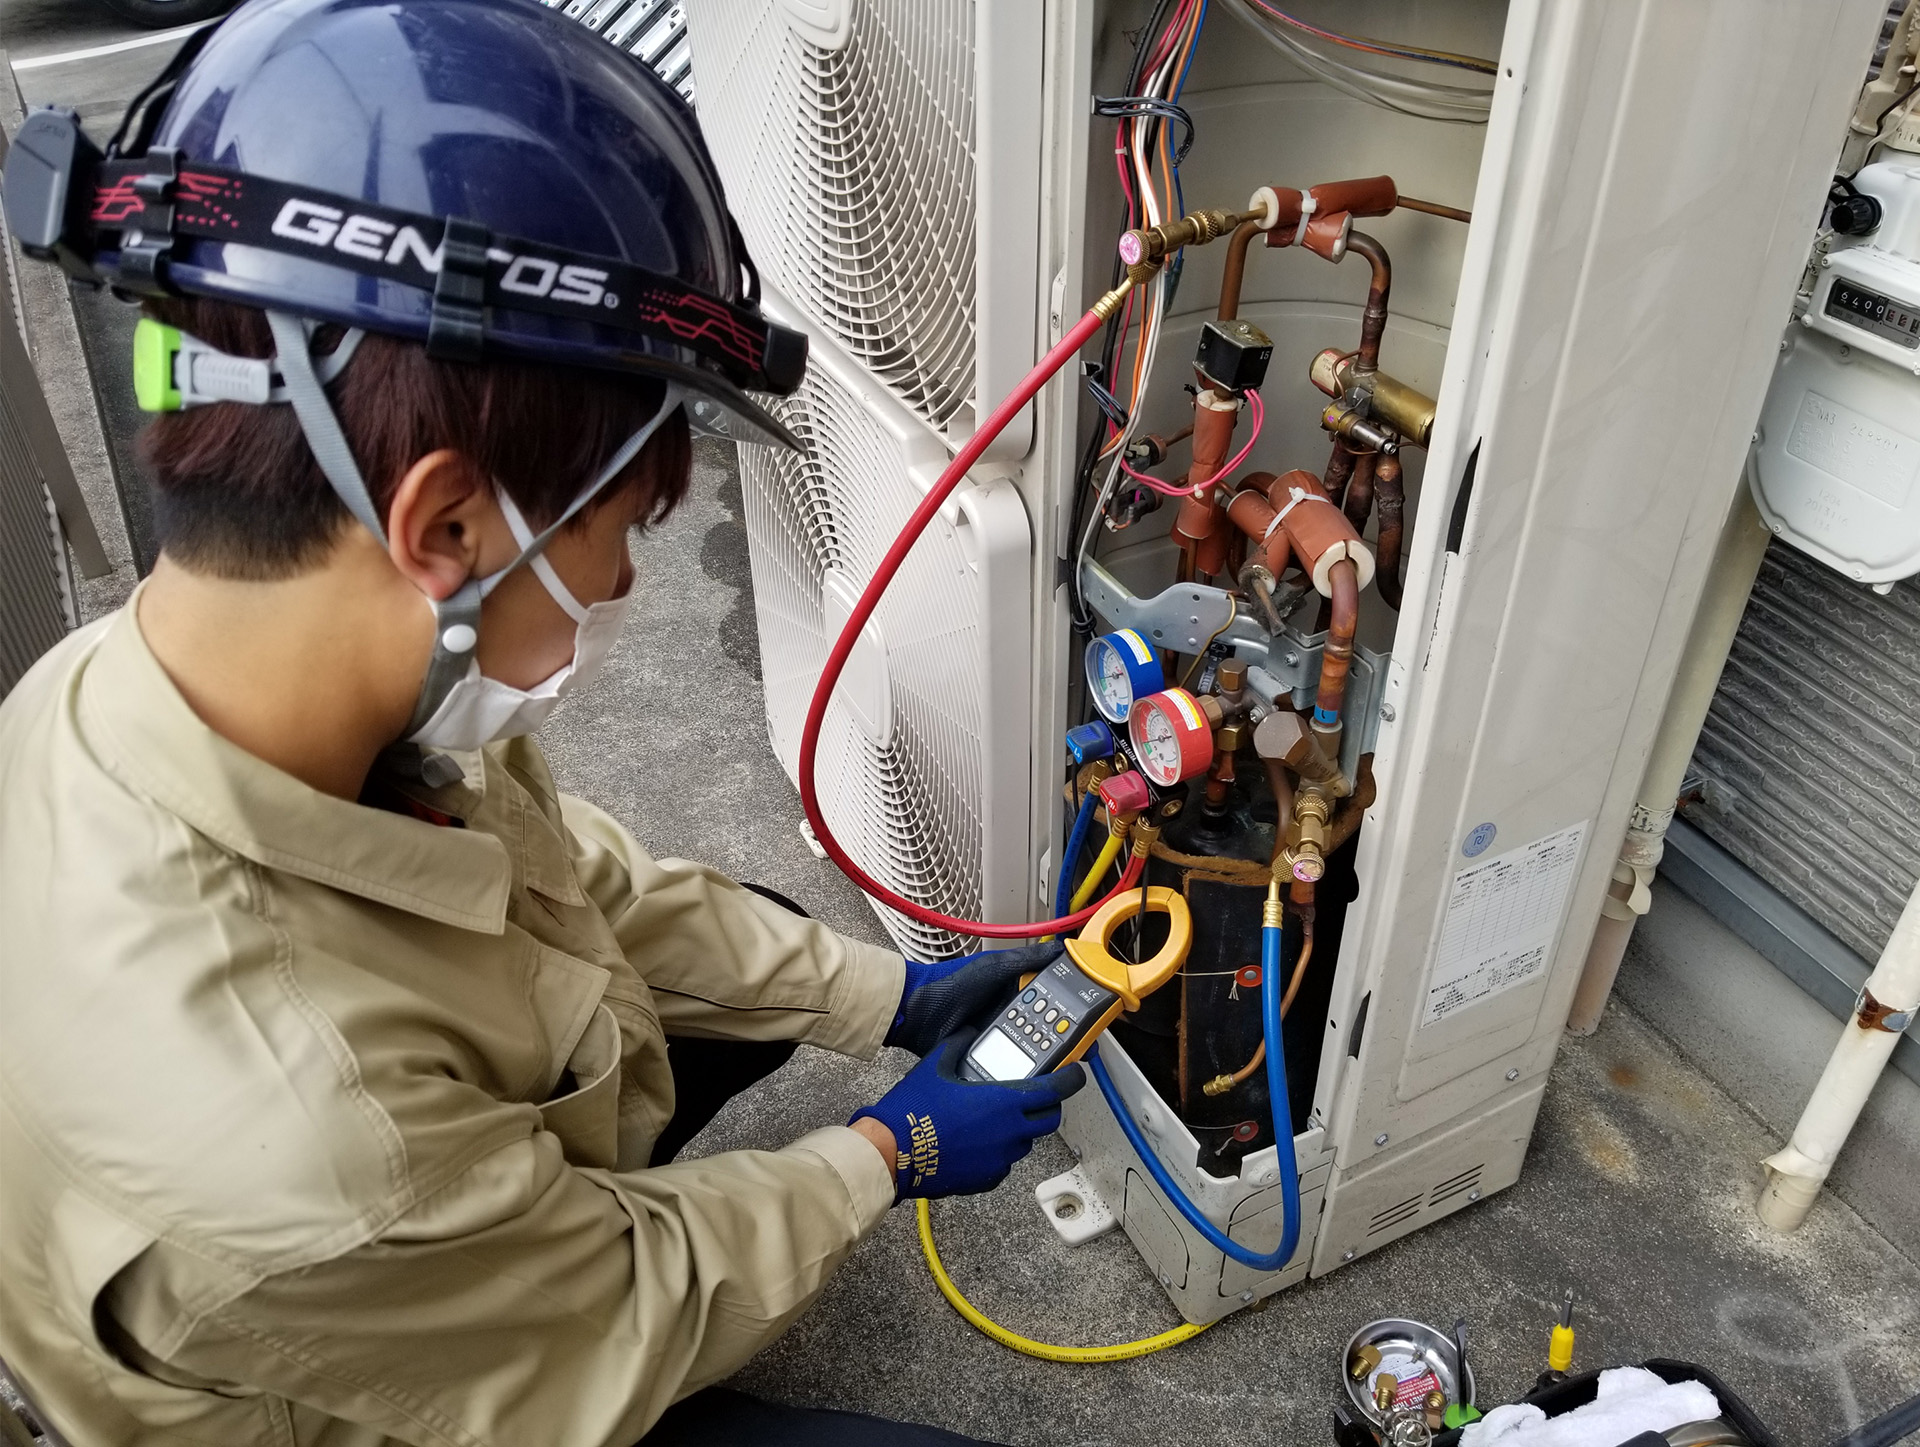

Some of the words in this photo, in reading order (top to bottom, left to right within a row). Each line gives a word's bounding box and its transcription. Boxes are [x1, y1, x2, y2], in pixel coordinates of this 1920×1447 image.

[1001, 1022, 1022, 1042] HIOKI
[1020, 1040, 1039, 1058] 3202
[910, 1126, 928, 1174] GRIP
[918, 1114, 940, 1177] BREATH
[979, 1324, 1018, 1348] REFRIGERANT
[1020, 1345, 1053, 1358] CHARGING
